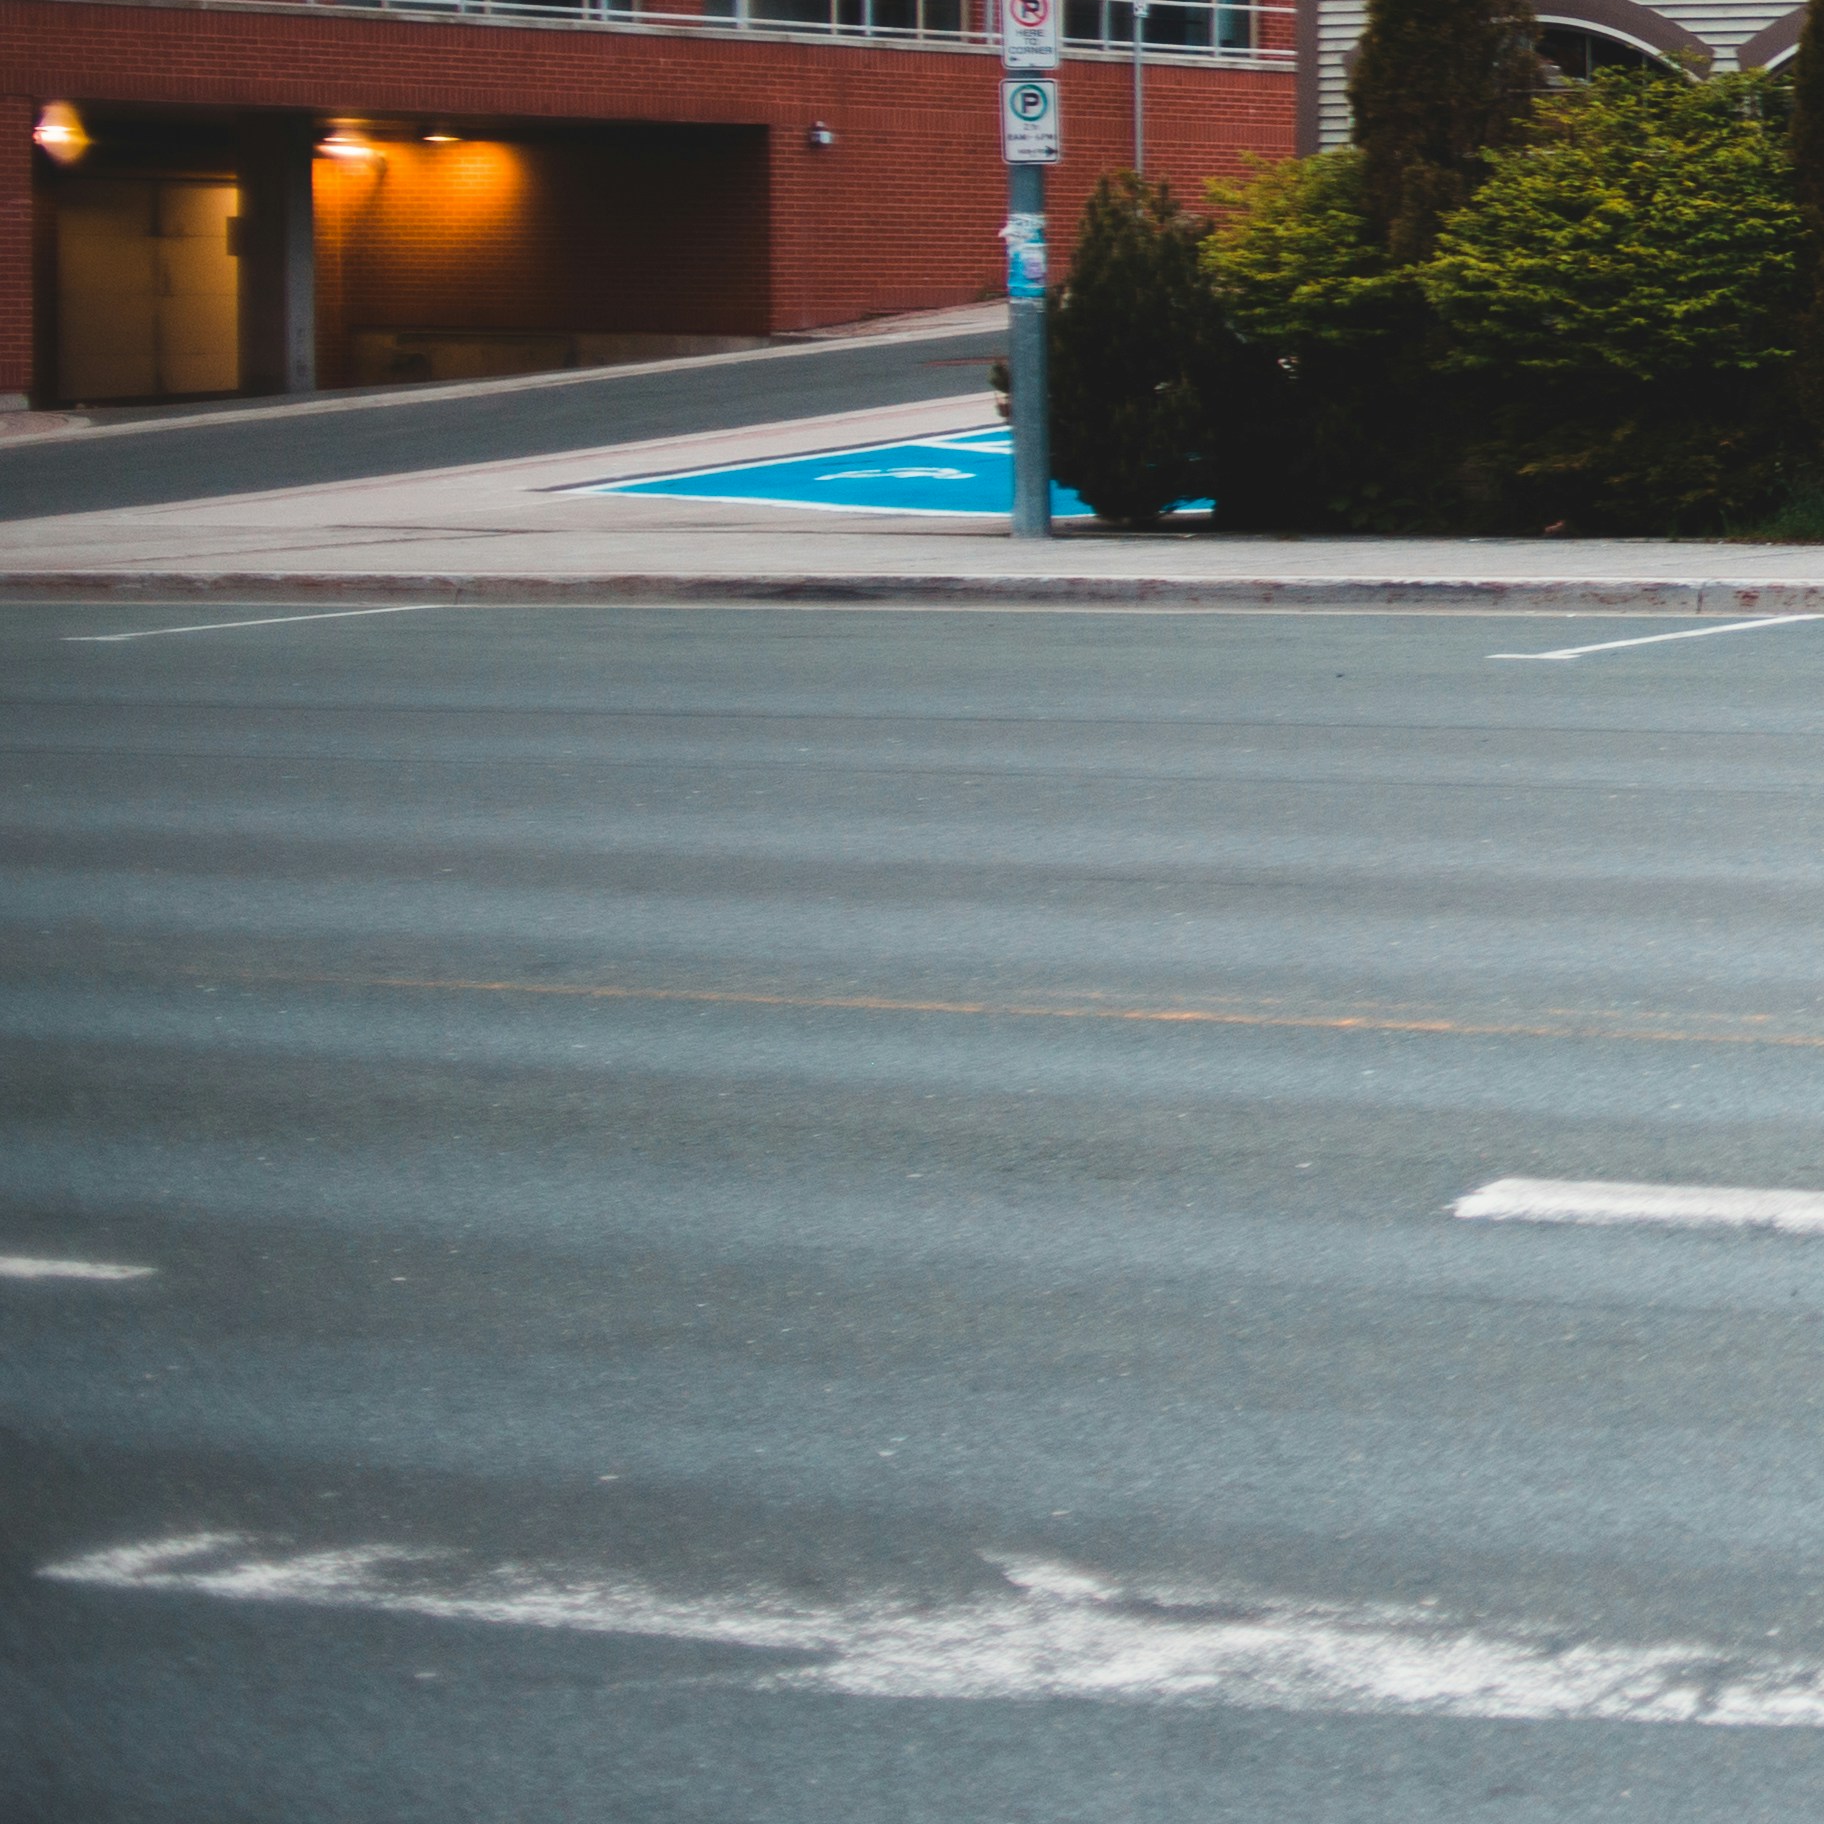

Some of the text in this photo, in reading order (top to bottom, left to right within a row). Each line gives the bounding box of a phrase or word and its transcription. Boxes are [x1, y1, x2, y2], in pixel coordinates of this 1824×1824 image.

[1015, 29, 1045, 37] HERE
[1024, 37, 1038, 46] TO
[1008, 46, 1053, 55] CORNER
[1021, 92, 1039, 114] P
